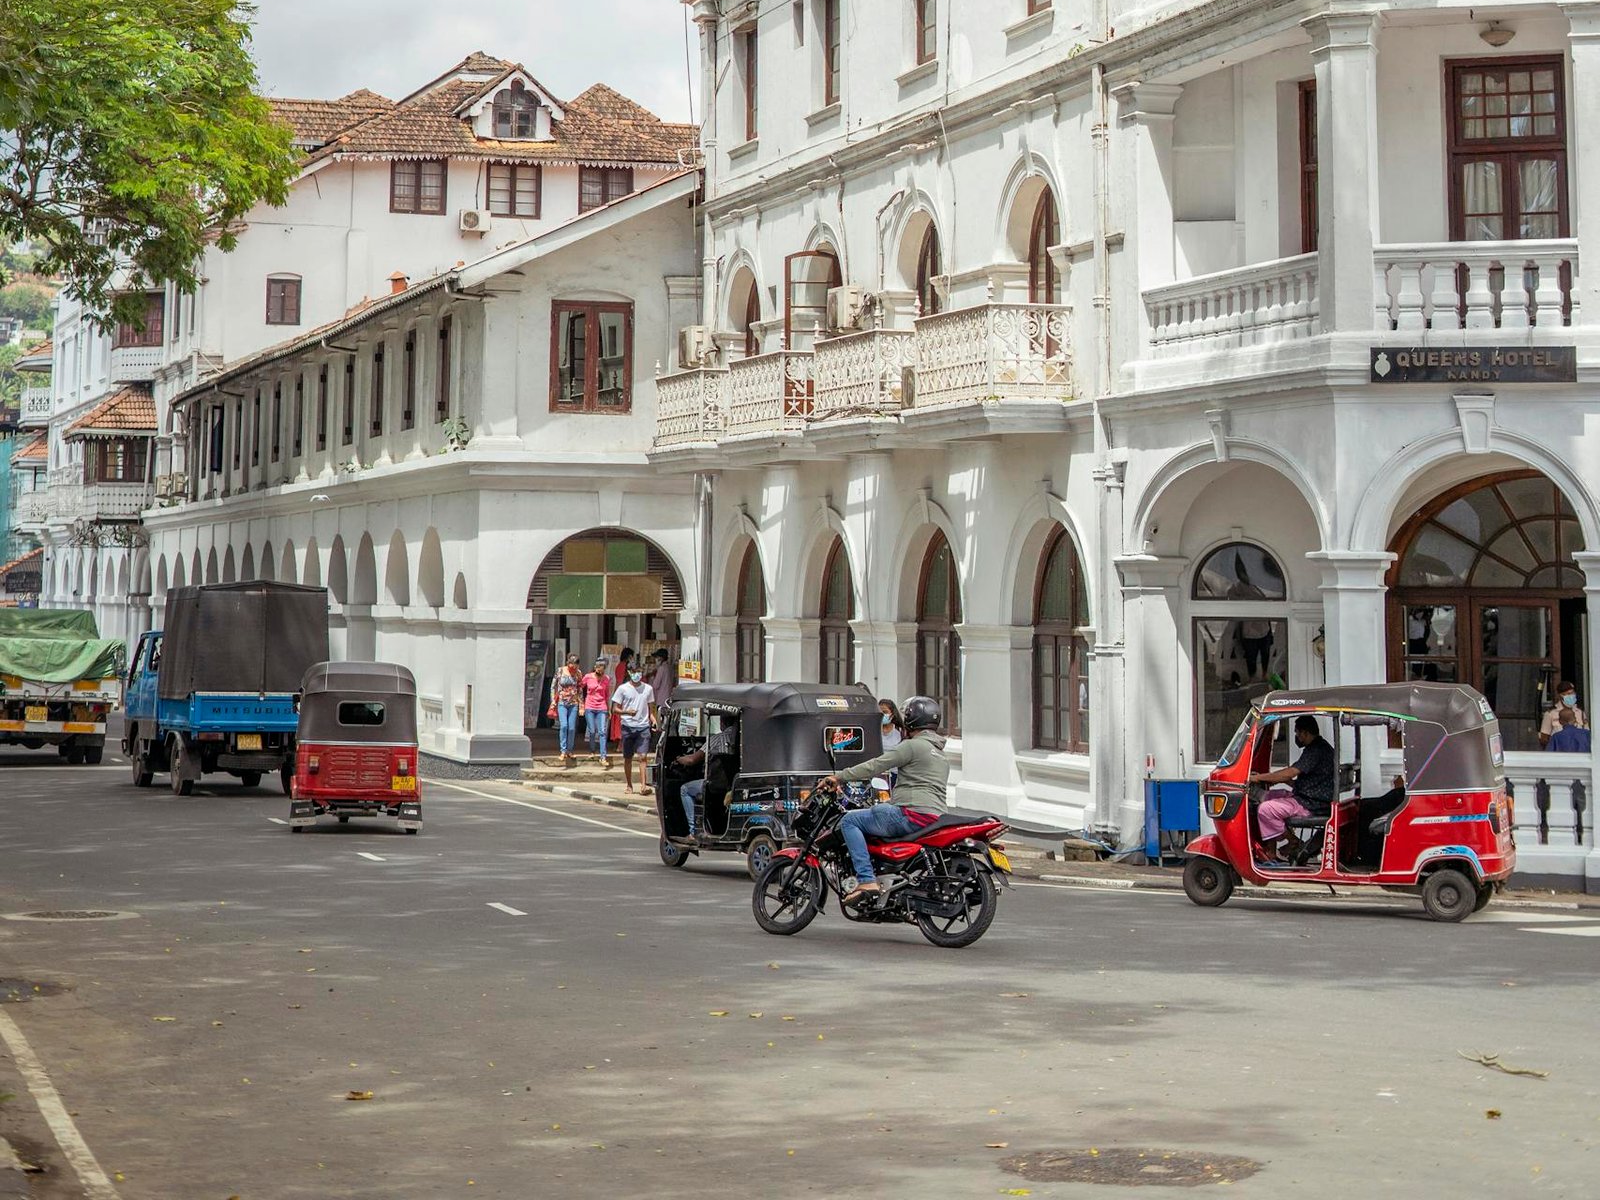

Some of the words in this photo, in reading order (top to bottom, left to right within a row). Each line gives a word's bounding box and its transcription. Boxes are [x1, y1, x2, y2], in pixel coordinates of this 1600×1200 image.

[1396, 351, 1481, 367] QUEENS
[1491, 351, 1559, 367] HOTEL
[1448, 370, 1501, 380] KANDY
